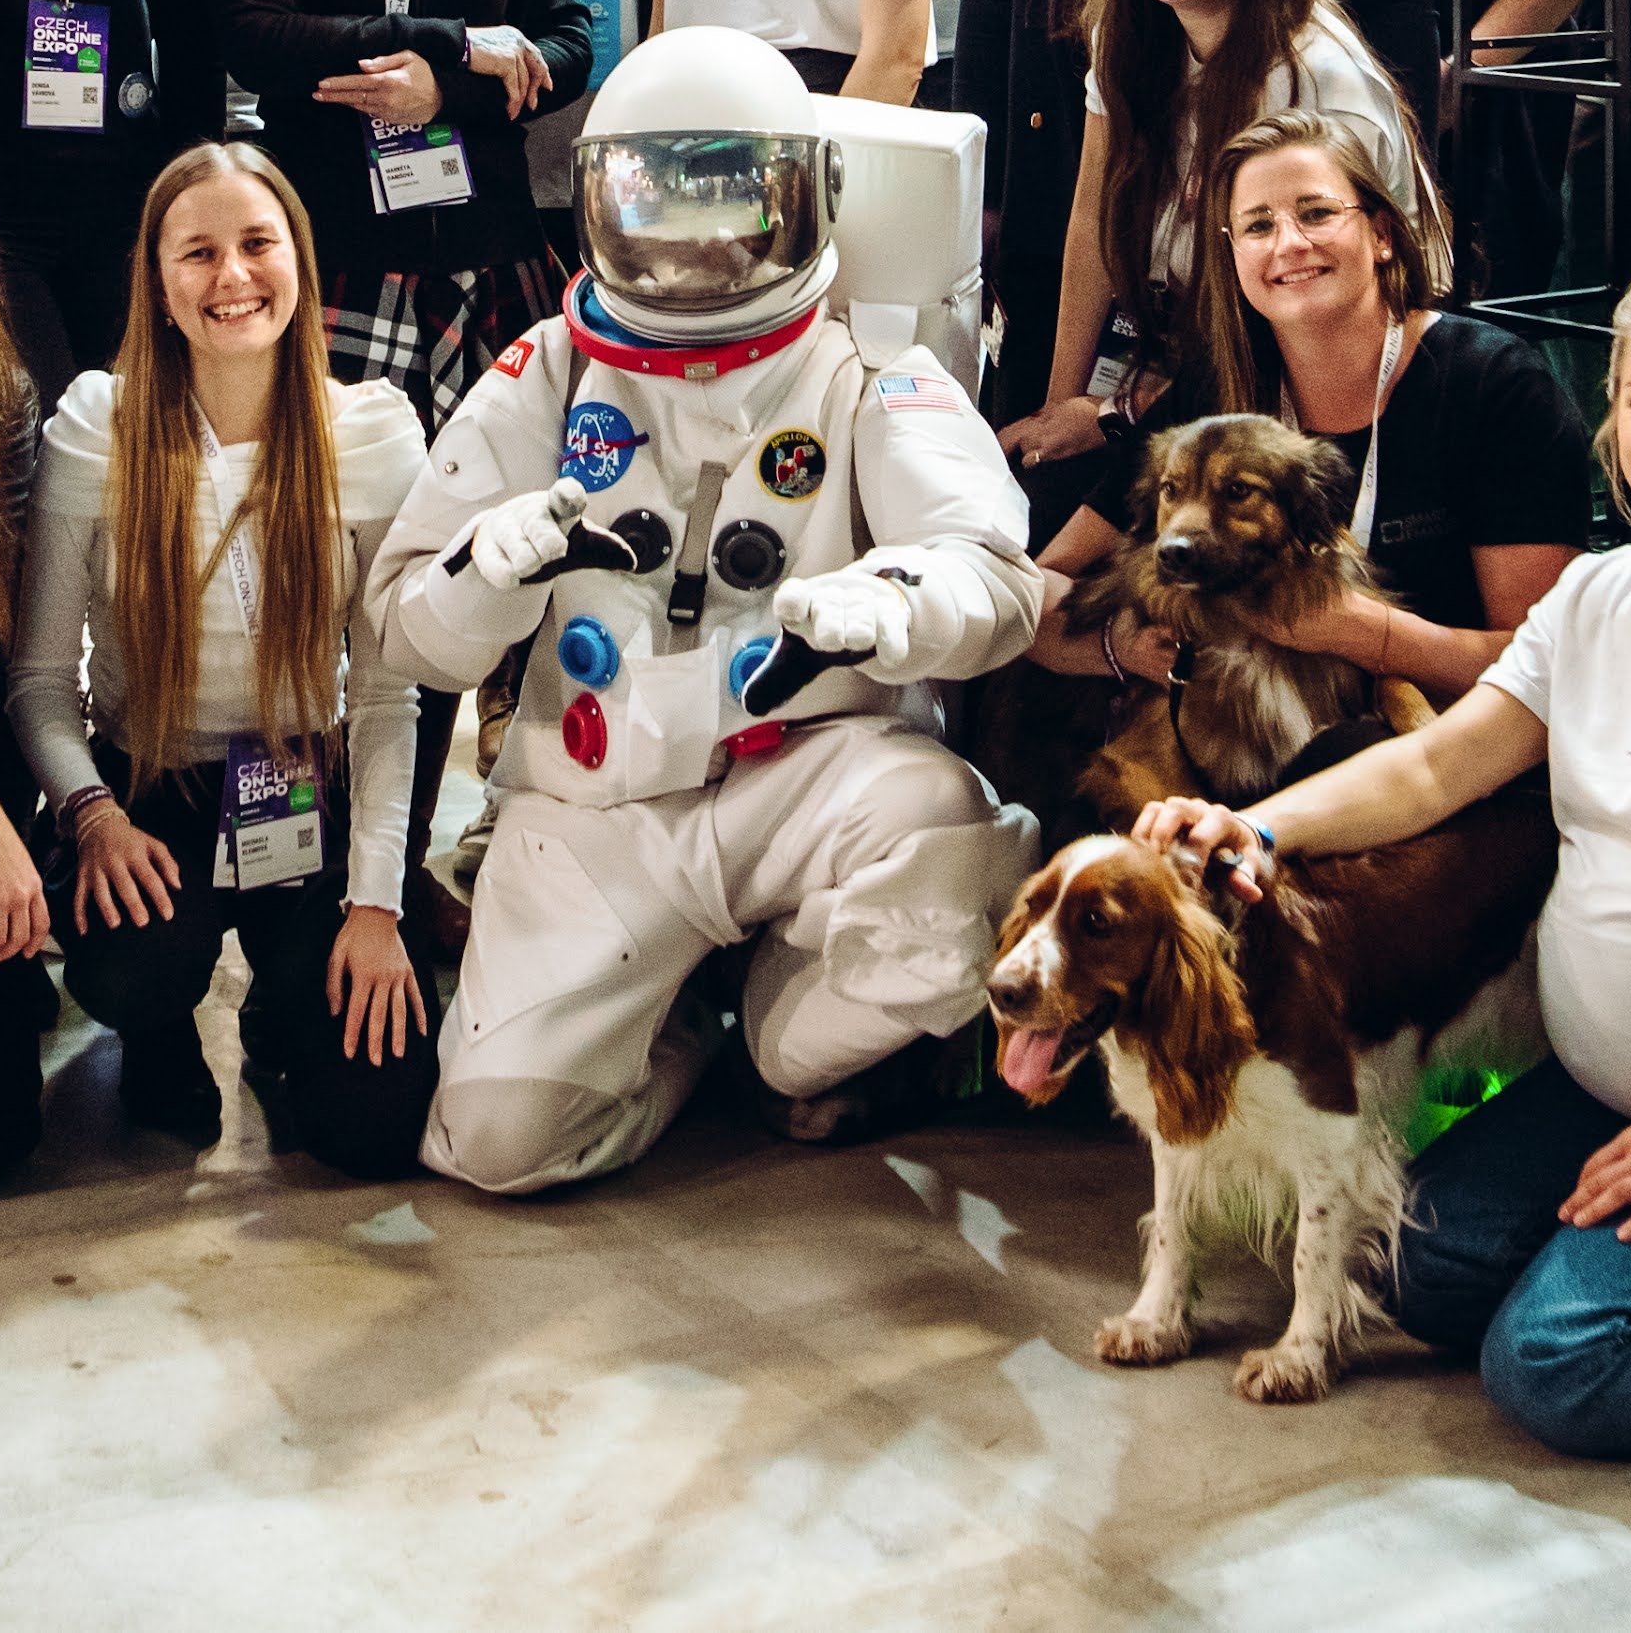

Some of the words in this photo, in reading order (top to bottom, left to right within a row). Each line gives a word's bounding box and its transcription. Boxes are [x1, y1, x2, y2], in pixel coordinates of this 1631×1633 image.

[34, 16, 88, 33] CZECH
[33, 28, 102, 46] ON-LINE
[33, 39, 79, 55] EXPO
[373, 123, 423, 141] EXPO
[231, 535, 248, 579] CZECH
[238, 783, 289, 805] EXPO
